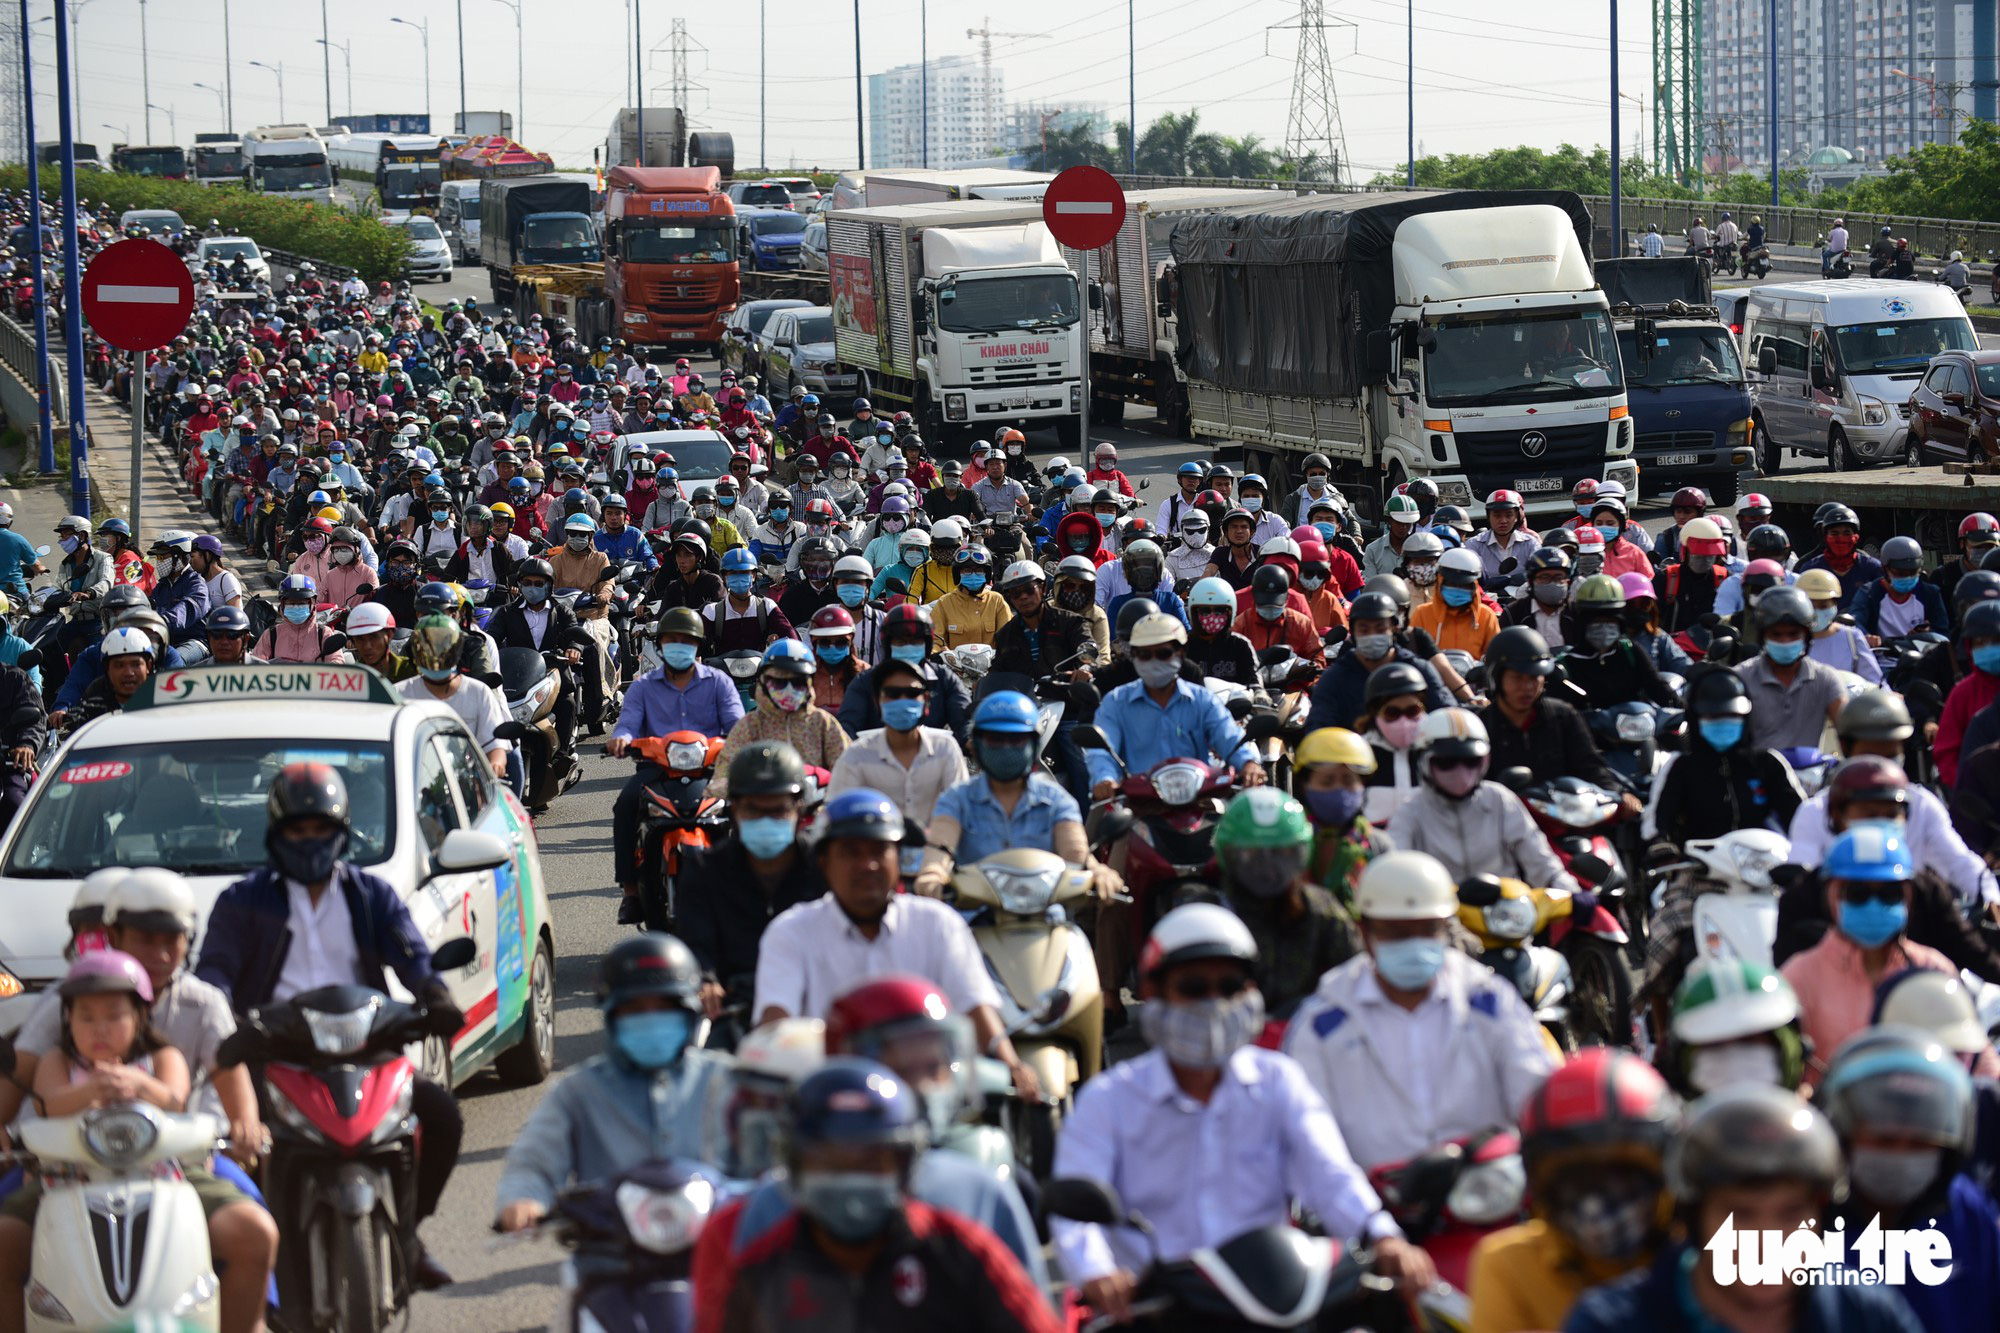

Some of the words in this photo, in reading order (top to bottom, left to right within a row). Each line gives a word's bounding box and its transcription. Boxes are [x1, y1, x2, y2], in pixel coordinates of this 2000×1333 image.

[396, 155, 416, 163] VIP
[980, 343, 1017, 358] KHÁNH
[1020, 340, 1050, 355] CHÂU
[997, 356, 1033, 364] ISUZU
[206, 673, 312, 692] VINASUN
[316, 671, 364, 692] TAXI
